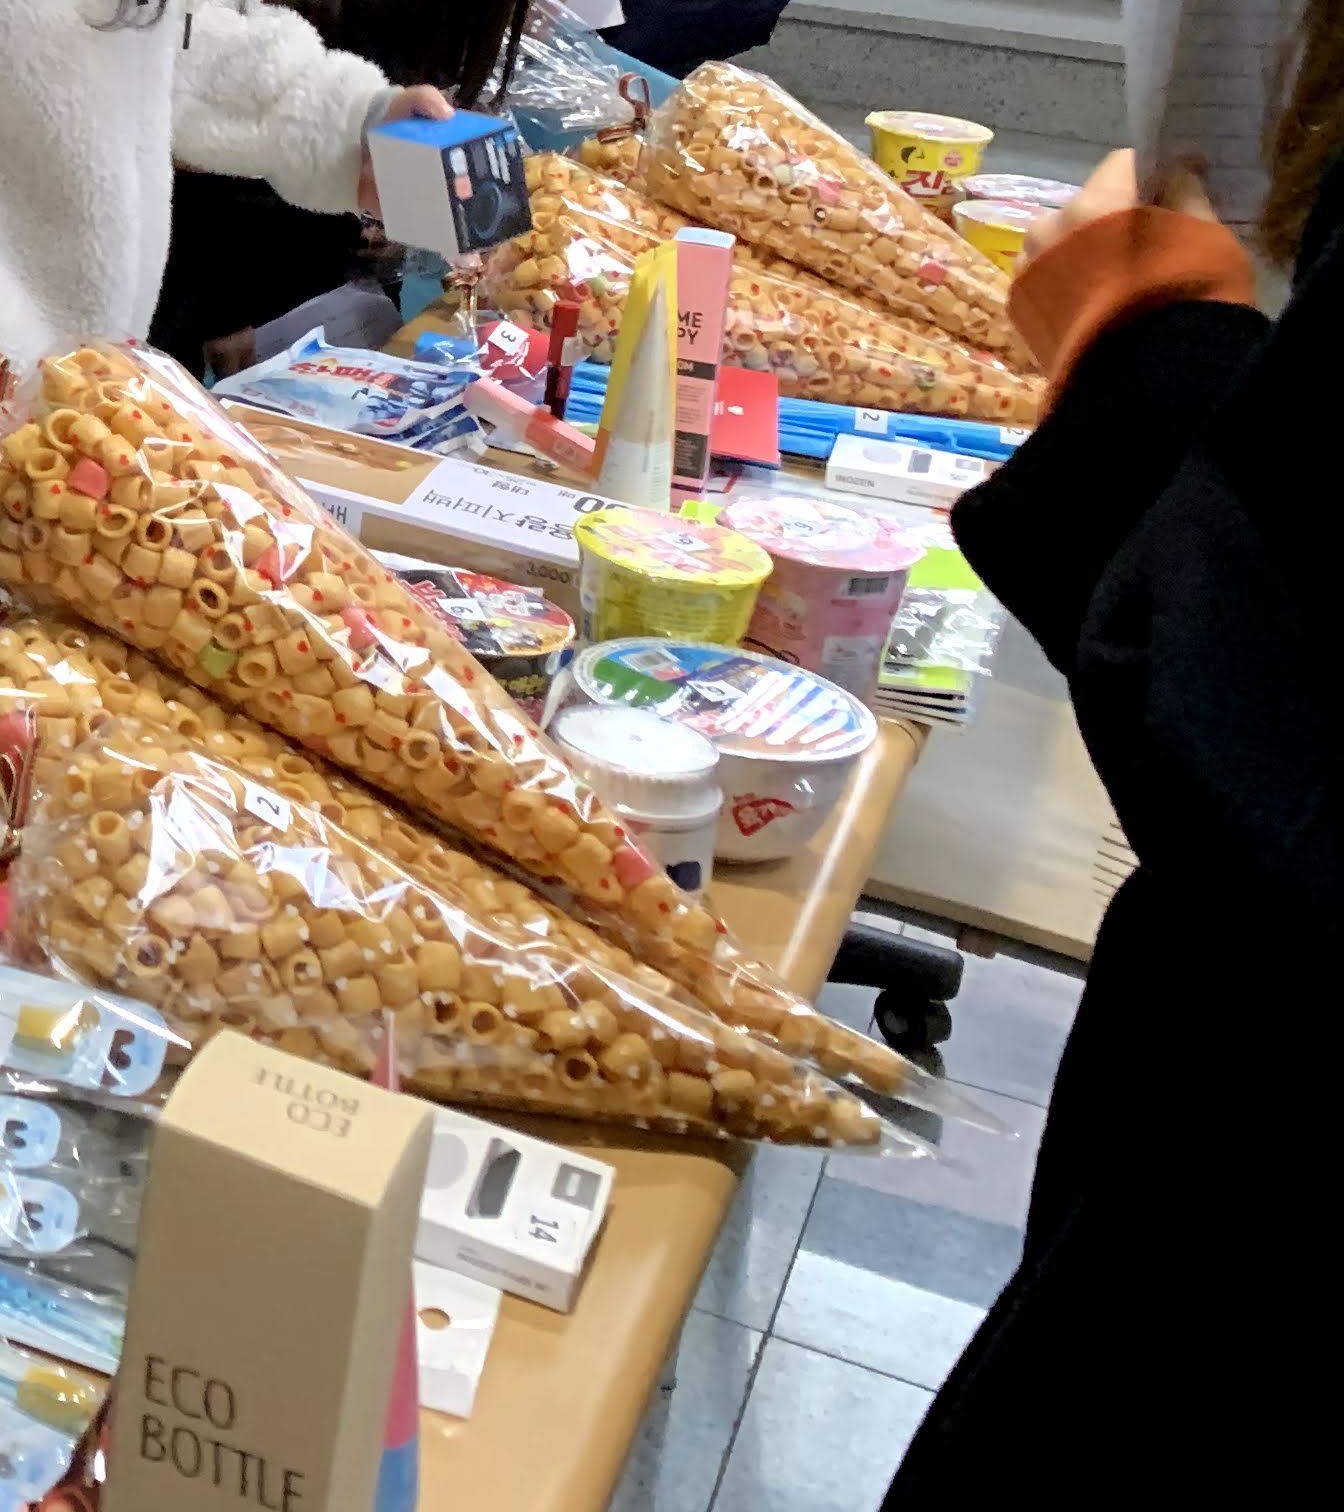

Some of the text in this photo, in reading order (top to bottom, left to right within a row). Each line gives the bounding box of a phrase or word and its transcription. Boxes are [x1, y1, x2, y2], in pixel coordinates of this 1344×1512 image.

[862, 411, 880, 422] 2
[422, 488, 514, 522] 지퍼백
[256, 795, 282, 815] 2
[528, 1212, 558, 1246] 14
[143, 1355, 236, 1431] ECO
[139, 1413, 306, 1512] BOTTLE
